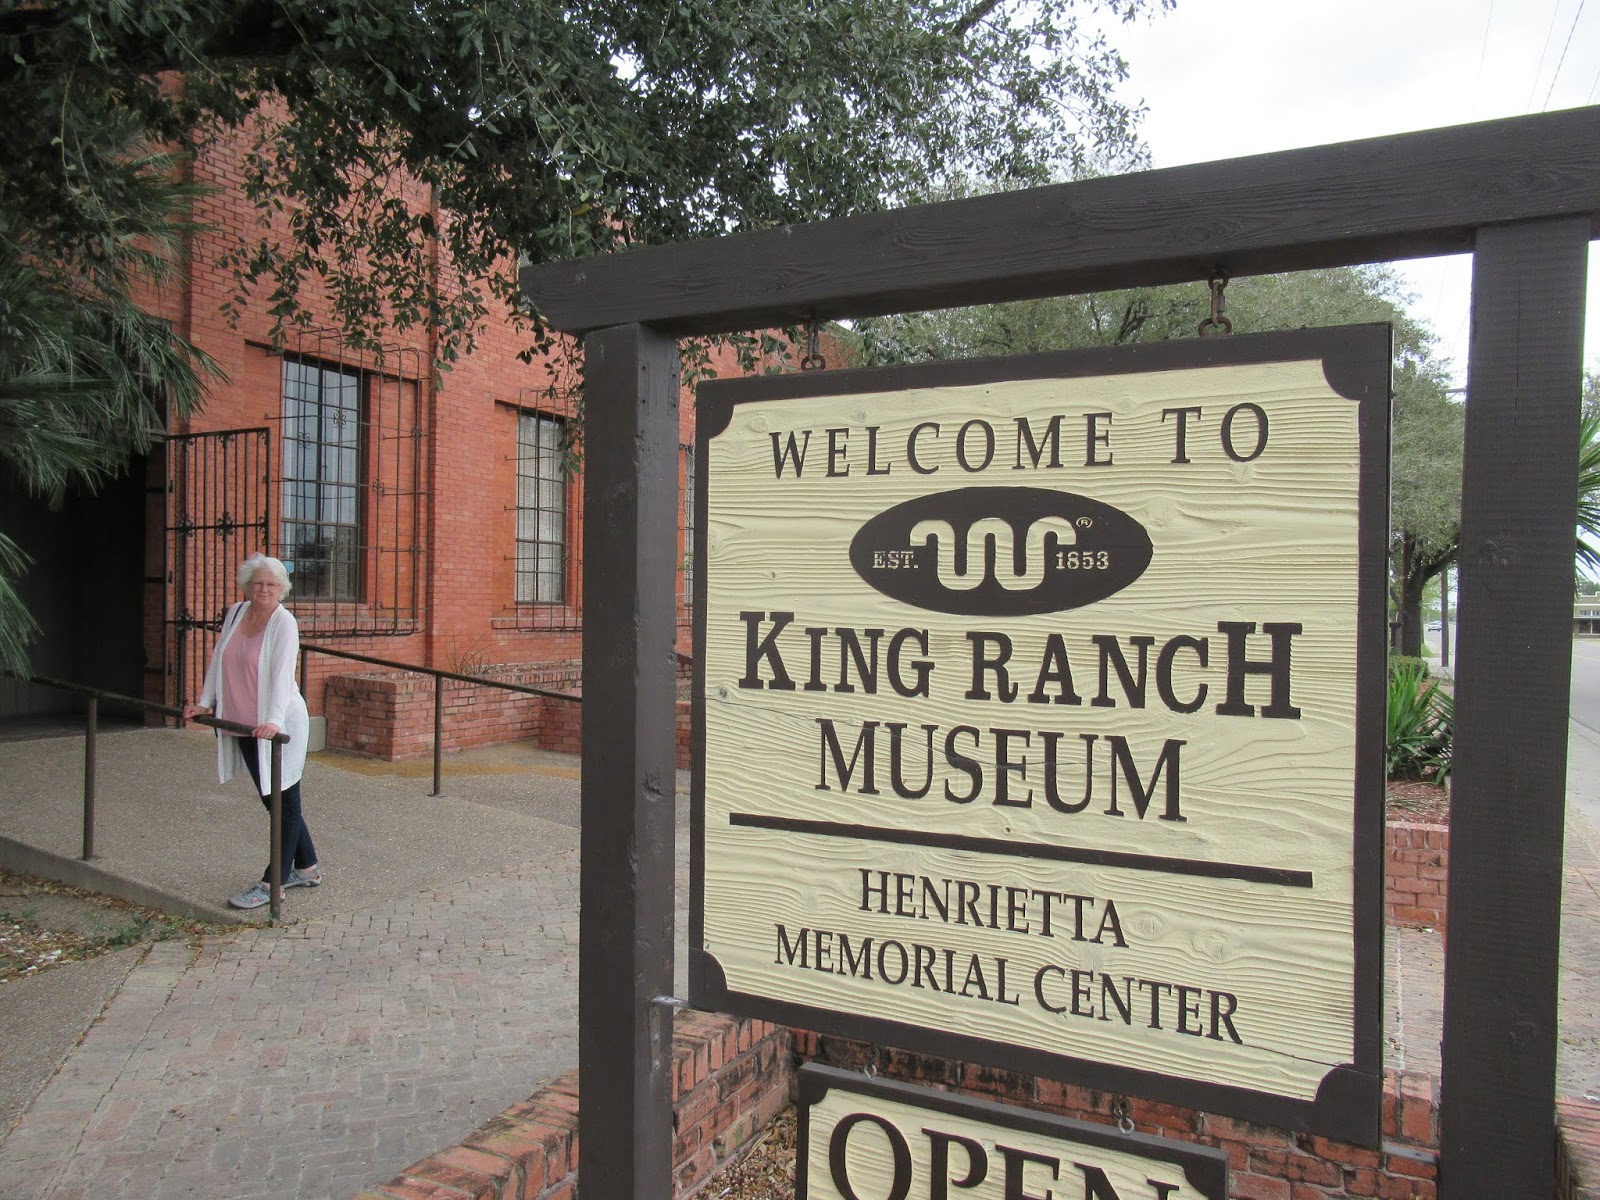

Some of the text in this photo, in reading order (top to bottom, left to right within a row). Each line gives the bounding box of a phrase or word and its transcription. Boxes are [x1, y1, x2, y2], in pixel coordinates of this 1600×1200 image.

[768, 402, 1269, 481] WELCOME TO
[872, 550, 1109, 570] EST. 1853
[738, 610, 1303, 720] KING RANCH
[814, 717, 1188, 823] MUSEUM
[858, 867, 1130, 949] HENRIETTA
[774, 923, 1243, 1045] MEMORIAL CENTER
